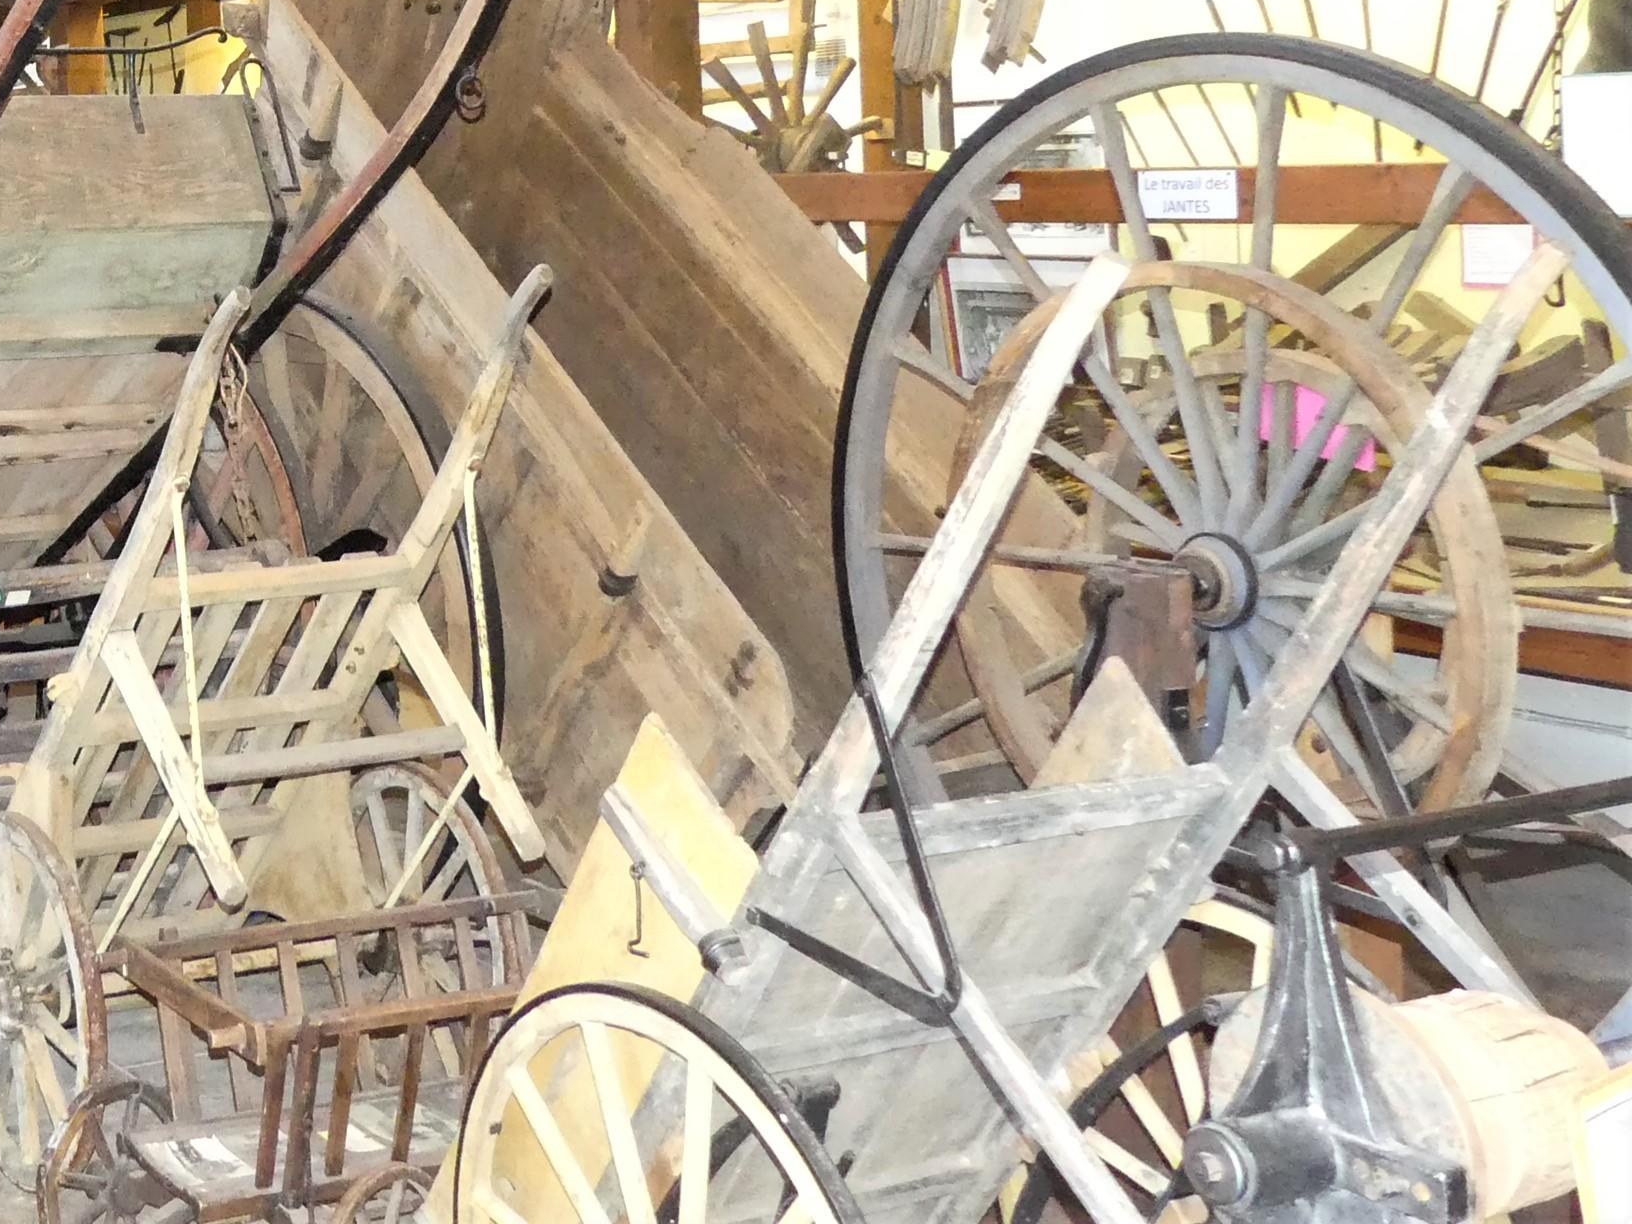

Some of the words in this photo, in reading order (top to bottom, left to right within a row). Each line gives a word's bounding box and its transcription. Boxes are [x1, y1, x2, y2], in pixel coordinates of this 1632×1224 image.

[1144, 176, 1158, 190] Le
[1161, 176, 1201, 190] travail
[1205, 176, 1229, 190] des
[1163, 200, 1210, 213] JANTES
